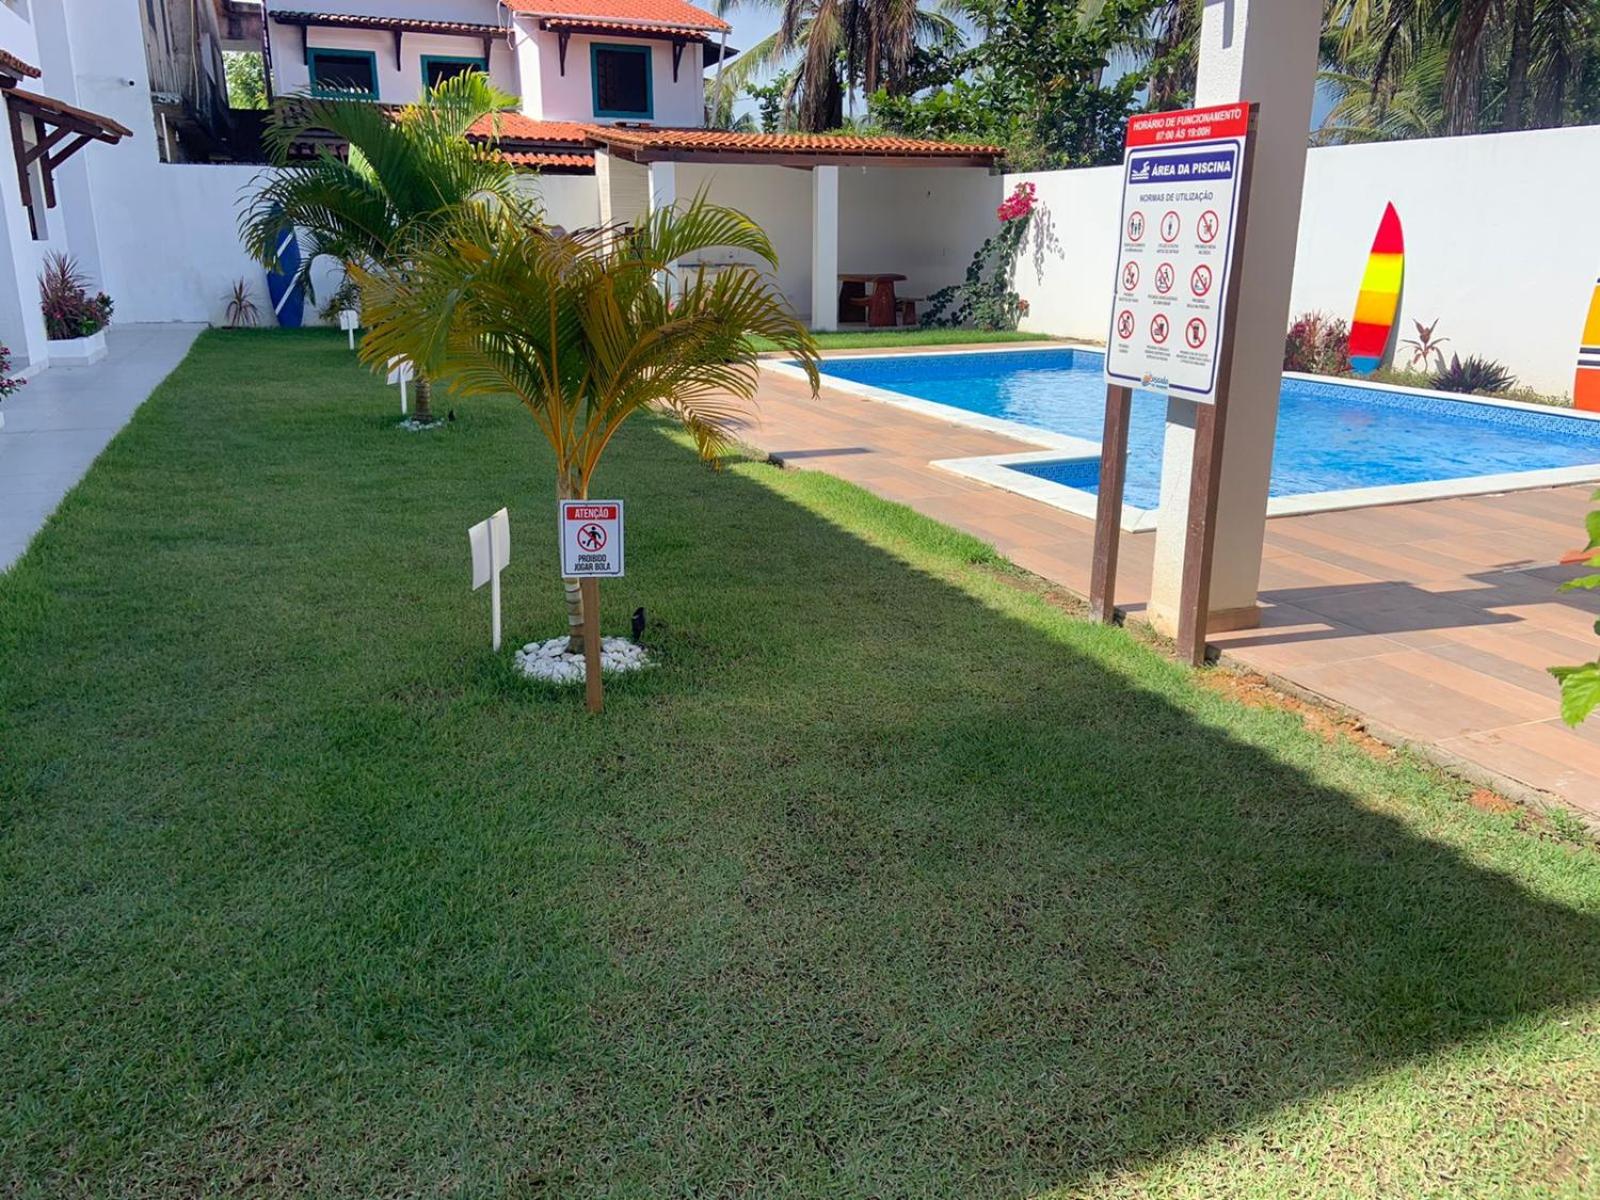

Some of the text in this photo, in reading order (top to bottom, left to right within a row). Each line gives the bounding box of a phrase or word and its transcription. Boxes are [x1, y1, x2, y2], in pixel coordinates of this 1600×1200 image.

[1133, 108, 1242, 131] HORÁRIO DE FUNCIONAMENTO
[1156, 130, 1174, 141] 07:00
[1151, 160, 1232, 177] ÁREA DA PISCINA
[1139, 190, 1213, 202] NORMAS DE UTILIZAÇÃO
[574, 507, 609, 519] ATENÇÃO
[578, 554, 607, 562] PROIBIDO
[574, 562, 611, 571] JOGAR BOLA
